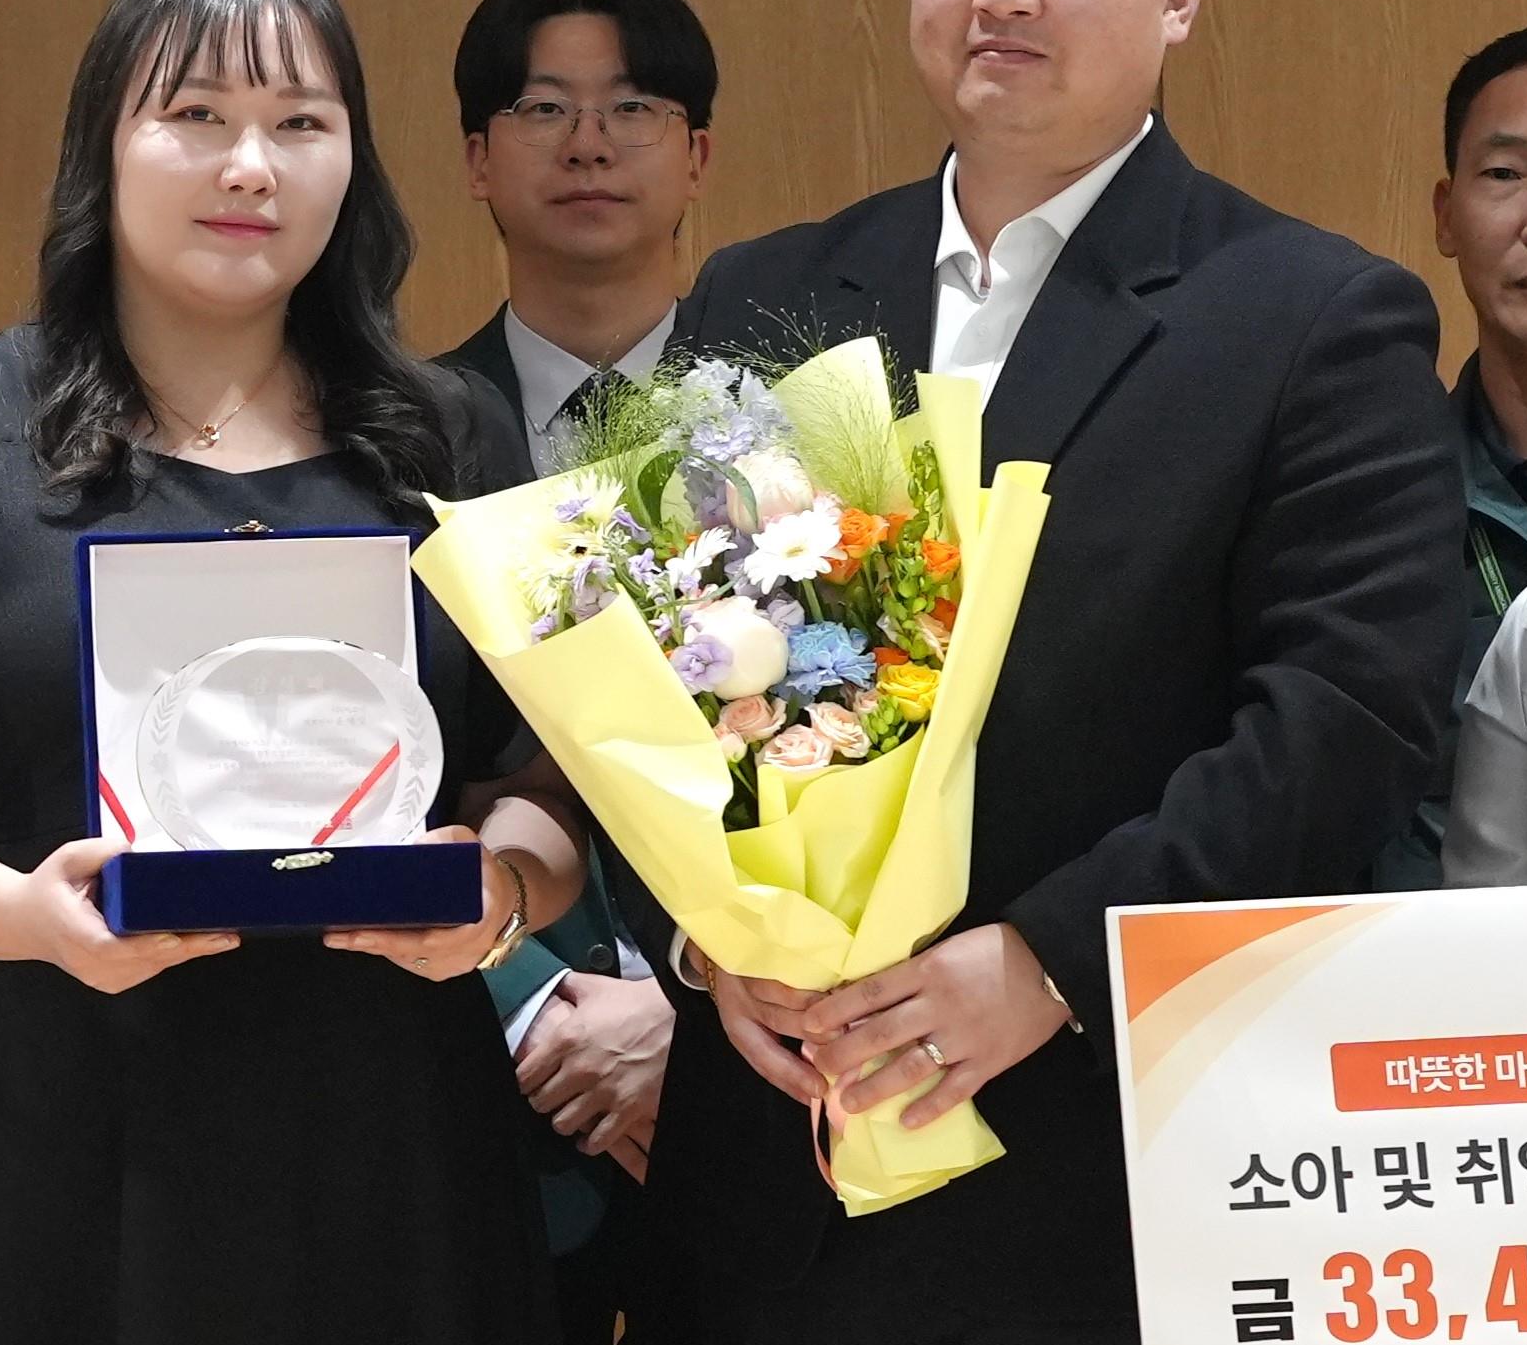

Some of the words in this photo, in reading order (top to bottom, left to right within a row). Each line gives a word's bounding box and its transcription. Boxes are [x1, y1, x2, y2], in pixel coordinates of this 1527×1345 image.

[1386, 1054, 1486, 1092] 따뜻한
[1229, 1146, 1353, 1213] 소아
[1374, 1142, 1434, 1210] 및
[1232, 1278, 1294, 1343] 금
